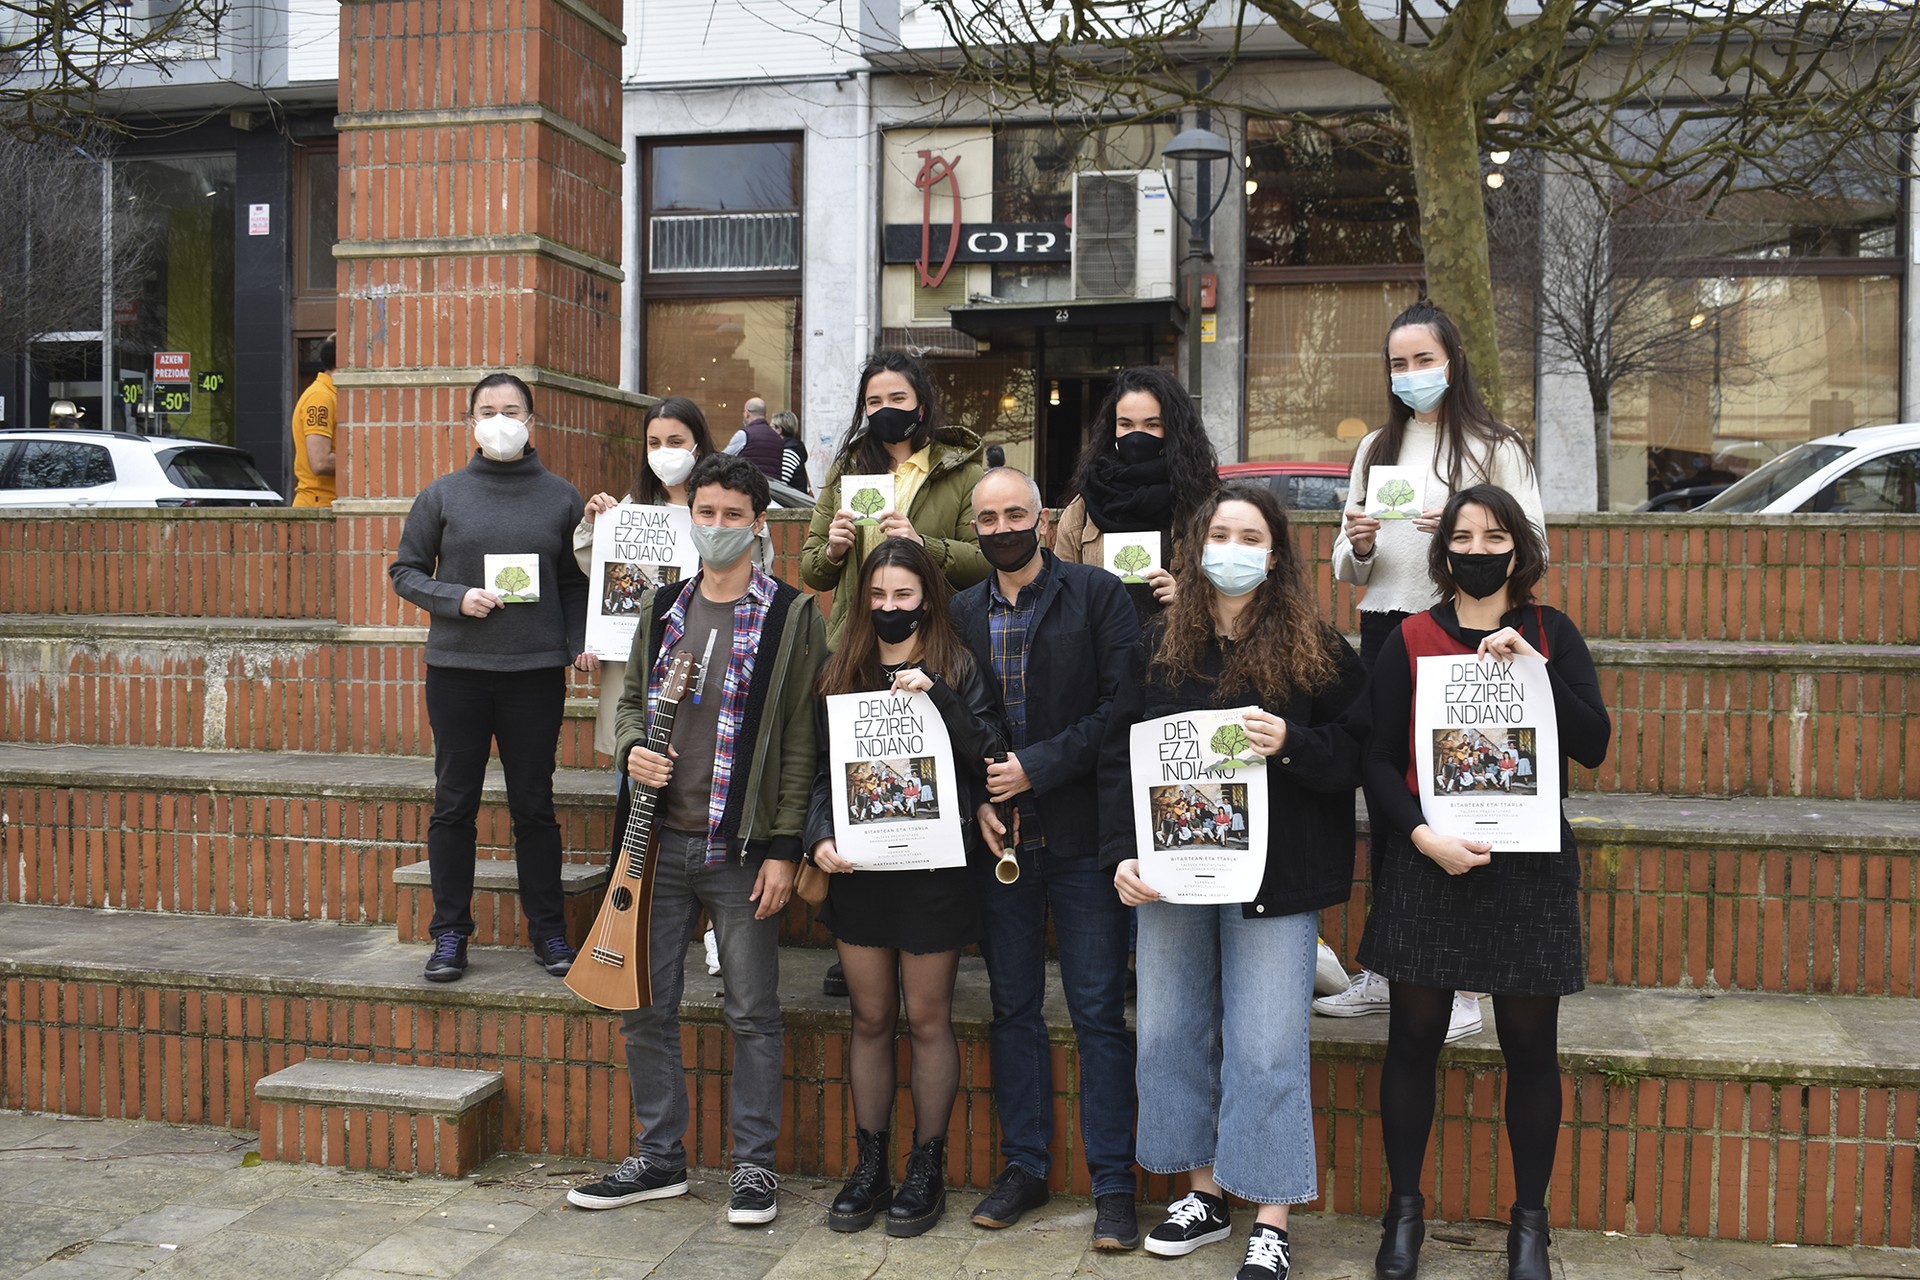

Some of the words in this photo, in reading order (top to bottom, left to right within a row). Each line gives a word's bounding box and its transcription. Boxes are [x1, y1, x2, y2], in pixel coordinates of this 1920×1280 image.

[160, 355, 183, 364] AZKEN
[155, 368, 190, 378] PREZIOAK
[161, 392, 190, 410] -50%
[306, 405, 329, 427] 32
[620, 510, 670, 529] DENAK
[614, 526, 633, 543] EZ
[634, 528, 677, 546] ZIREN
[615, 543, 673, 562] INDIANO
[1451, 661, 1515, 683] DENAK
[1445, 684, 1468, 704] EZ
[1470, 683, 1525, 703] ZIREN
[858, 696, 914, 719] DENAK
[1446, 703, 1524, 725] INDIANO
[854, 719, 874, 739] EZ
[876, 715, 924, 737] ZIREN
[1164, 720, 1199, 741] DEN
[856, 735, 924, 758] INDIANO
[1159, 742, 1182, 761] EZ
